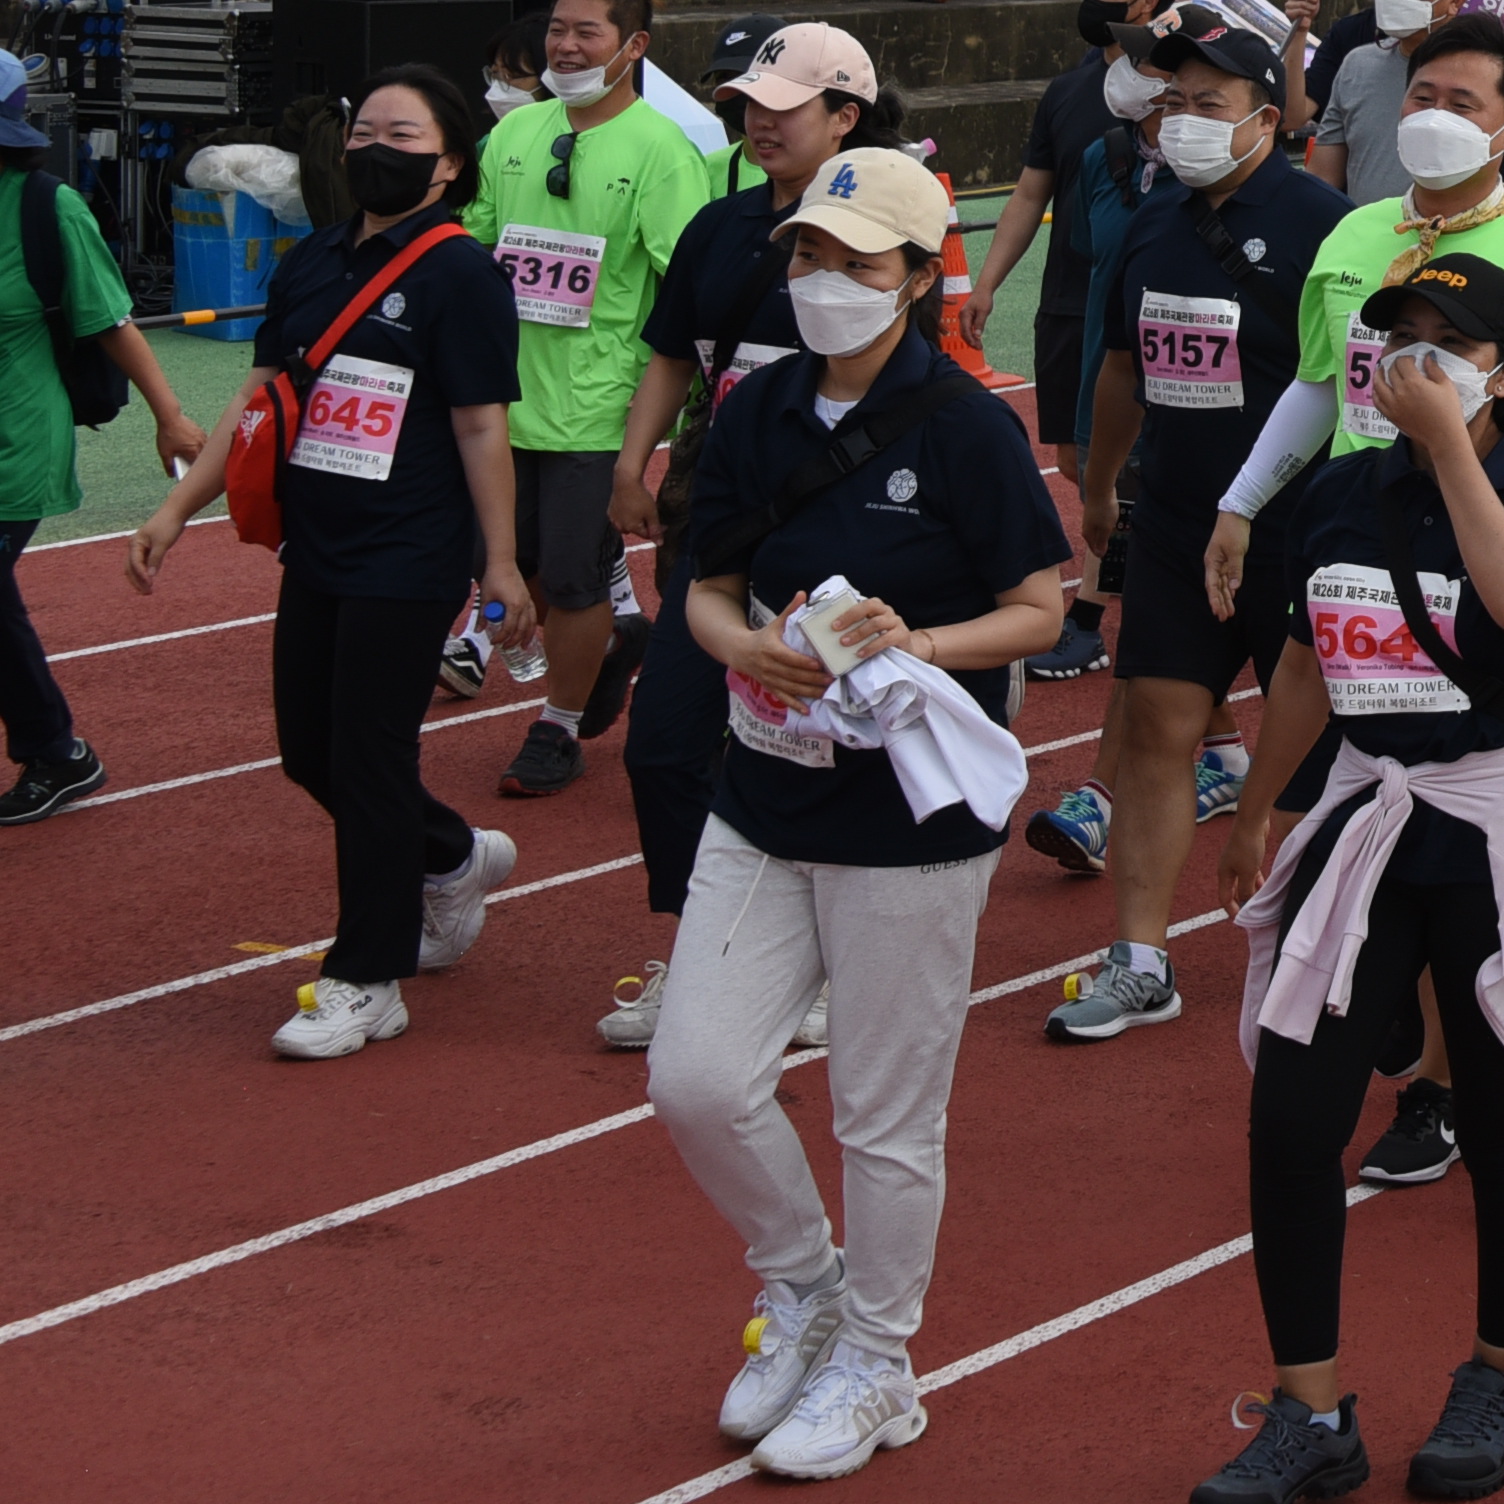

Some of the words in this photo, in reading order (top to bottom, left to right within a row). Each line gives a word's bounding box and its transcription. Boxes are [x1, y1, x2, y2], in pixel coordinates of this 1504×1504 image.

[756, 37, 786, 65] NY
[828, 163, 857, 199] LA
[524, 239, 600, 259] 제주국제관광마라톤축제
[500, 253, 592, 294] 5316
[1340, 270, 1363, 287] Jeju
[516, 299, 547, 312] DREAM
[550, 304, 582, 316] TOWER
[1160, 308, 1234, 325] 제주국제관광마라톤축제
[1351, 327, 1376, 341] 제26회
[1142, 328, 1230, 368] 5157
[322, 369, 405, 394] 주국제관광마라톤축제
[1162, 381, 1192, 394] DREAM
[1195, 382, 1231, 394] TOWER
[310, 390, 396, 437] 645
[303, 442, 336, 456] DREAM
[339, 448, 380, 465] TOWER
[1312, 582, 1343, 599] 제26회
[1345, 586, 1453, 610] 제주국제관톤축제
[1316, 612, 1419, 662] 564
[1356, 663, 1382, 671] Veronika
[1384, 663, 1404, 672] Tobing
[1347, 682, 1399, 695] DREAM
[1404, 680, 1456, 693] TOWER
[1348, 698, 1386, 710] 드림타워
[1389, 696, 1437, 708] 복합리조트
[920, 858, 968, 875] GUESS
